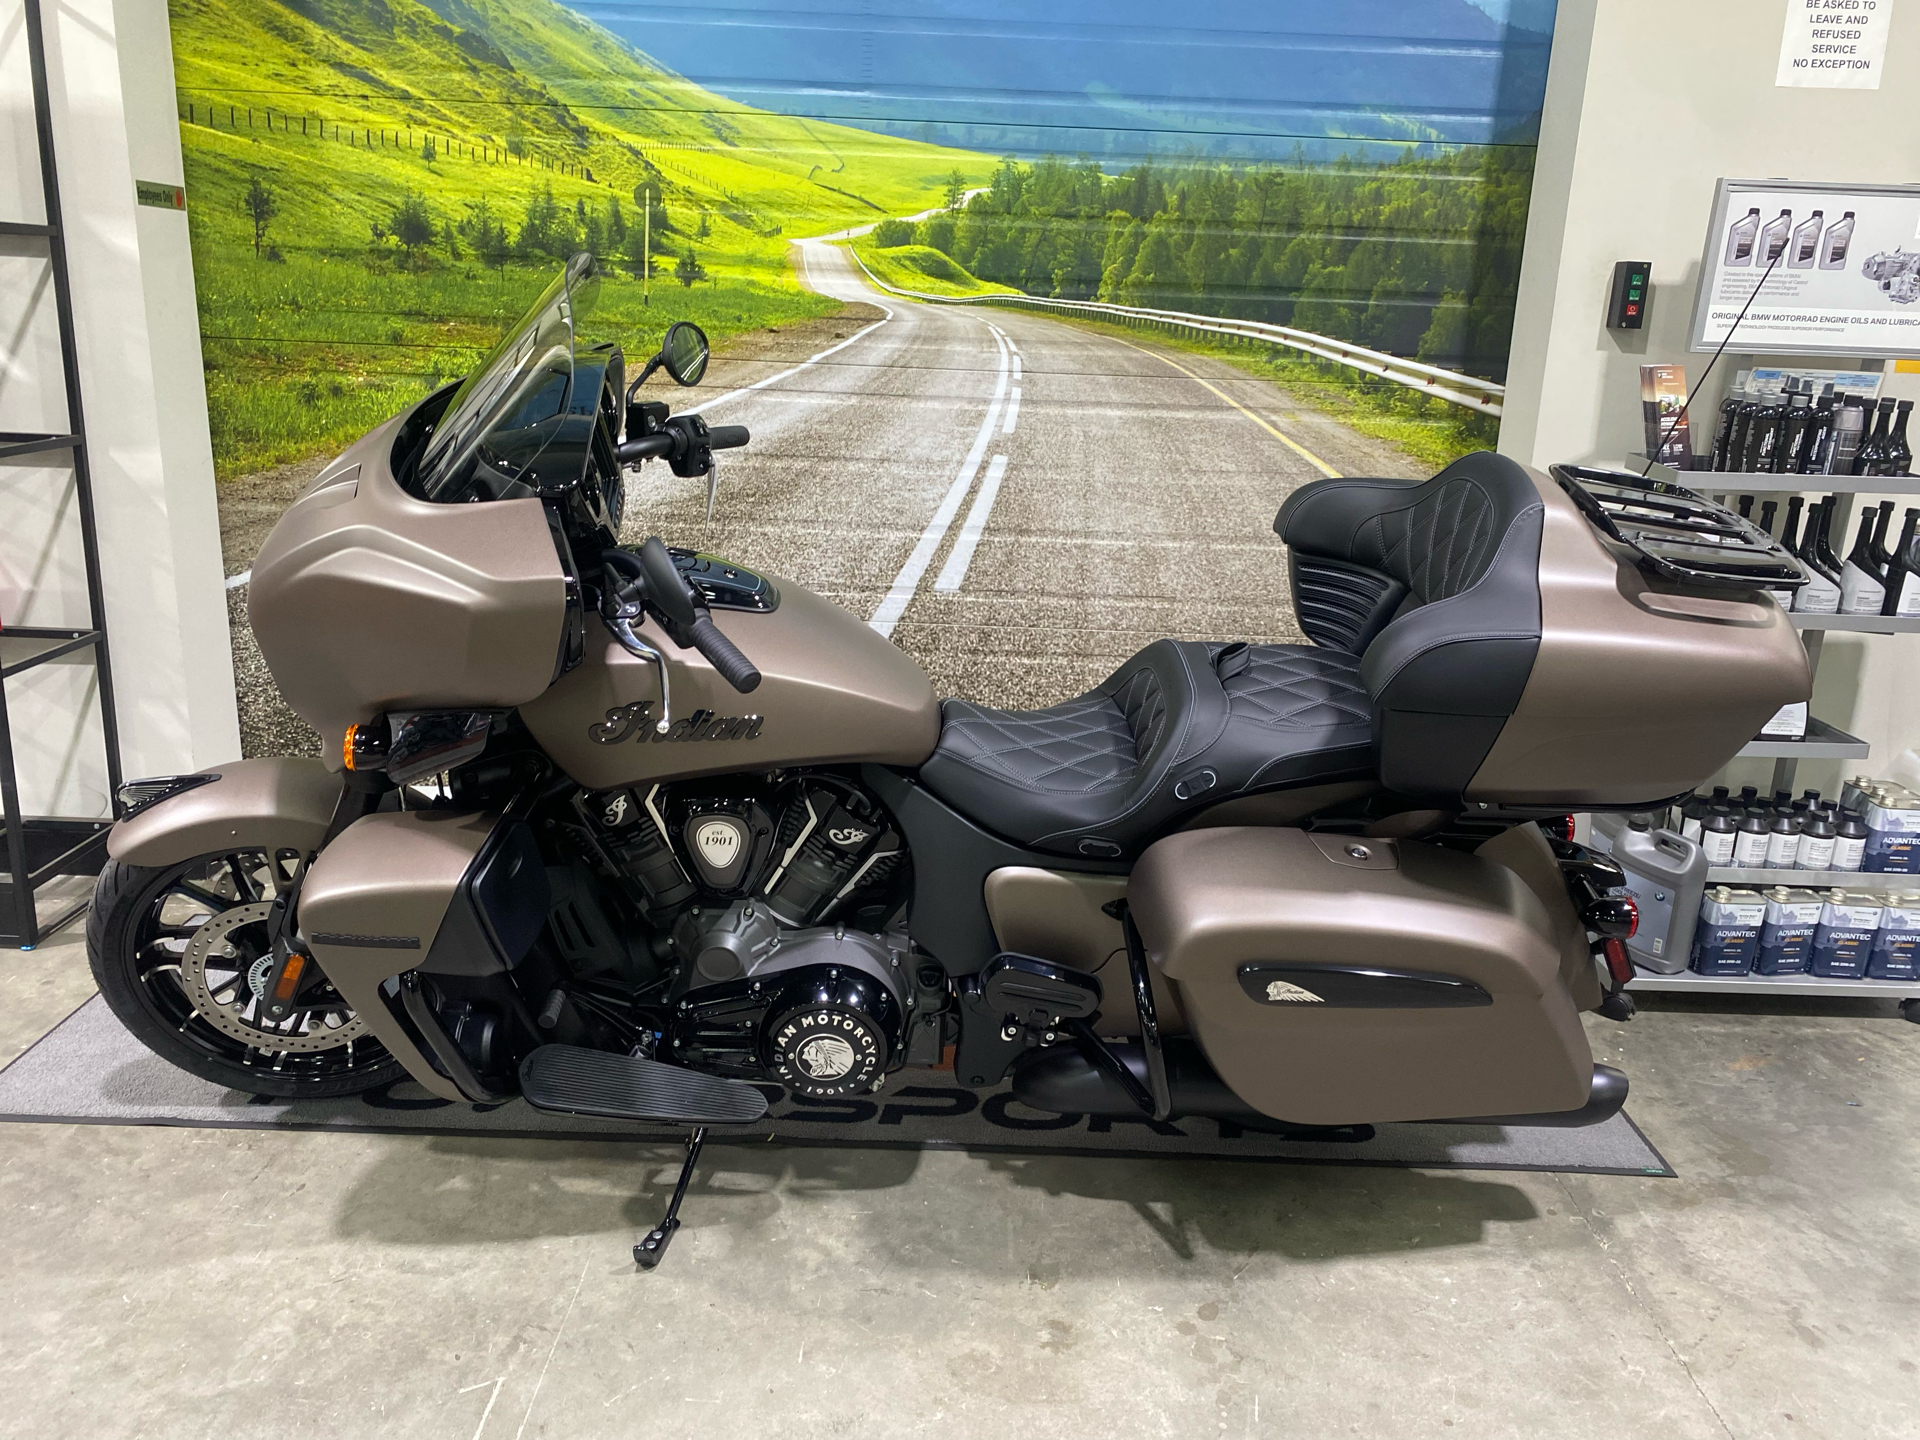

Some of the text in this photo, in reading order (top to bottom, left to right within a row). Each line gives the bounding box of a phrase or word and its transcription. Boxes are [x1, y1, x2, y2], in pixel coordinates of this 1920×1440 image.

[1806, 0, 1876, 10] BE ASKED TO
[1809, 14, 1868, 25] LEAVE AND
[1812, 29, 1861, 39] REFUSED
[1811, 44, 1857, 54] SERVICE
[1793, 58, 1870, 69] NO EXCEPTION
[1712, 312, 1749, 320] ORIGINAL
[1751, 313, 1771, 321] BMW
[1772, 314, 1818, 322] MOTORRAD
[1820, 316, 1849, 324] ENGINE
[1870, 317, 1888, 325] AND
[588, 701, 764, 745] Indian
[705, 836, 733, 846] 1901
[1717, 930, 1756, 938] ADVANTEC
[1830, 932, 1871, 941] ADVANTEC
[1886, 934, 1920, 942] ADVANTE
[775, 1014, 876, 1082] INDIAN MOTORCYCLE
[807, 1086, 844, 1095] 1901
